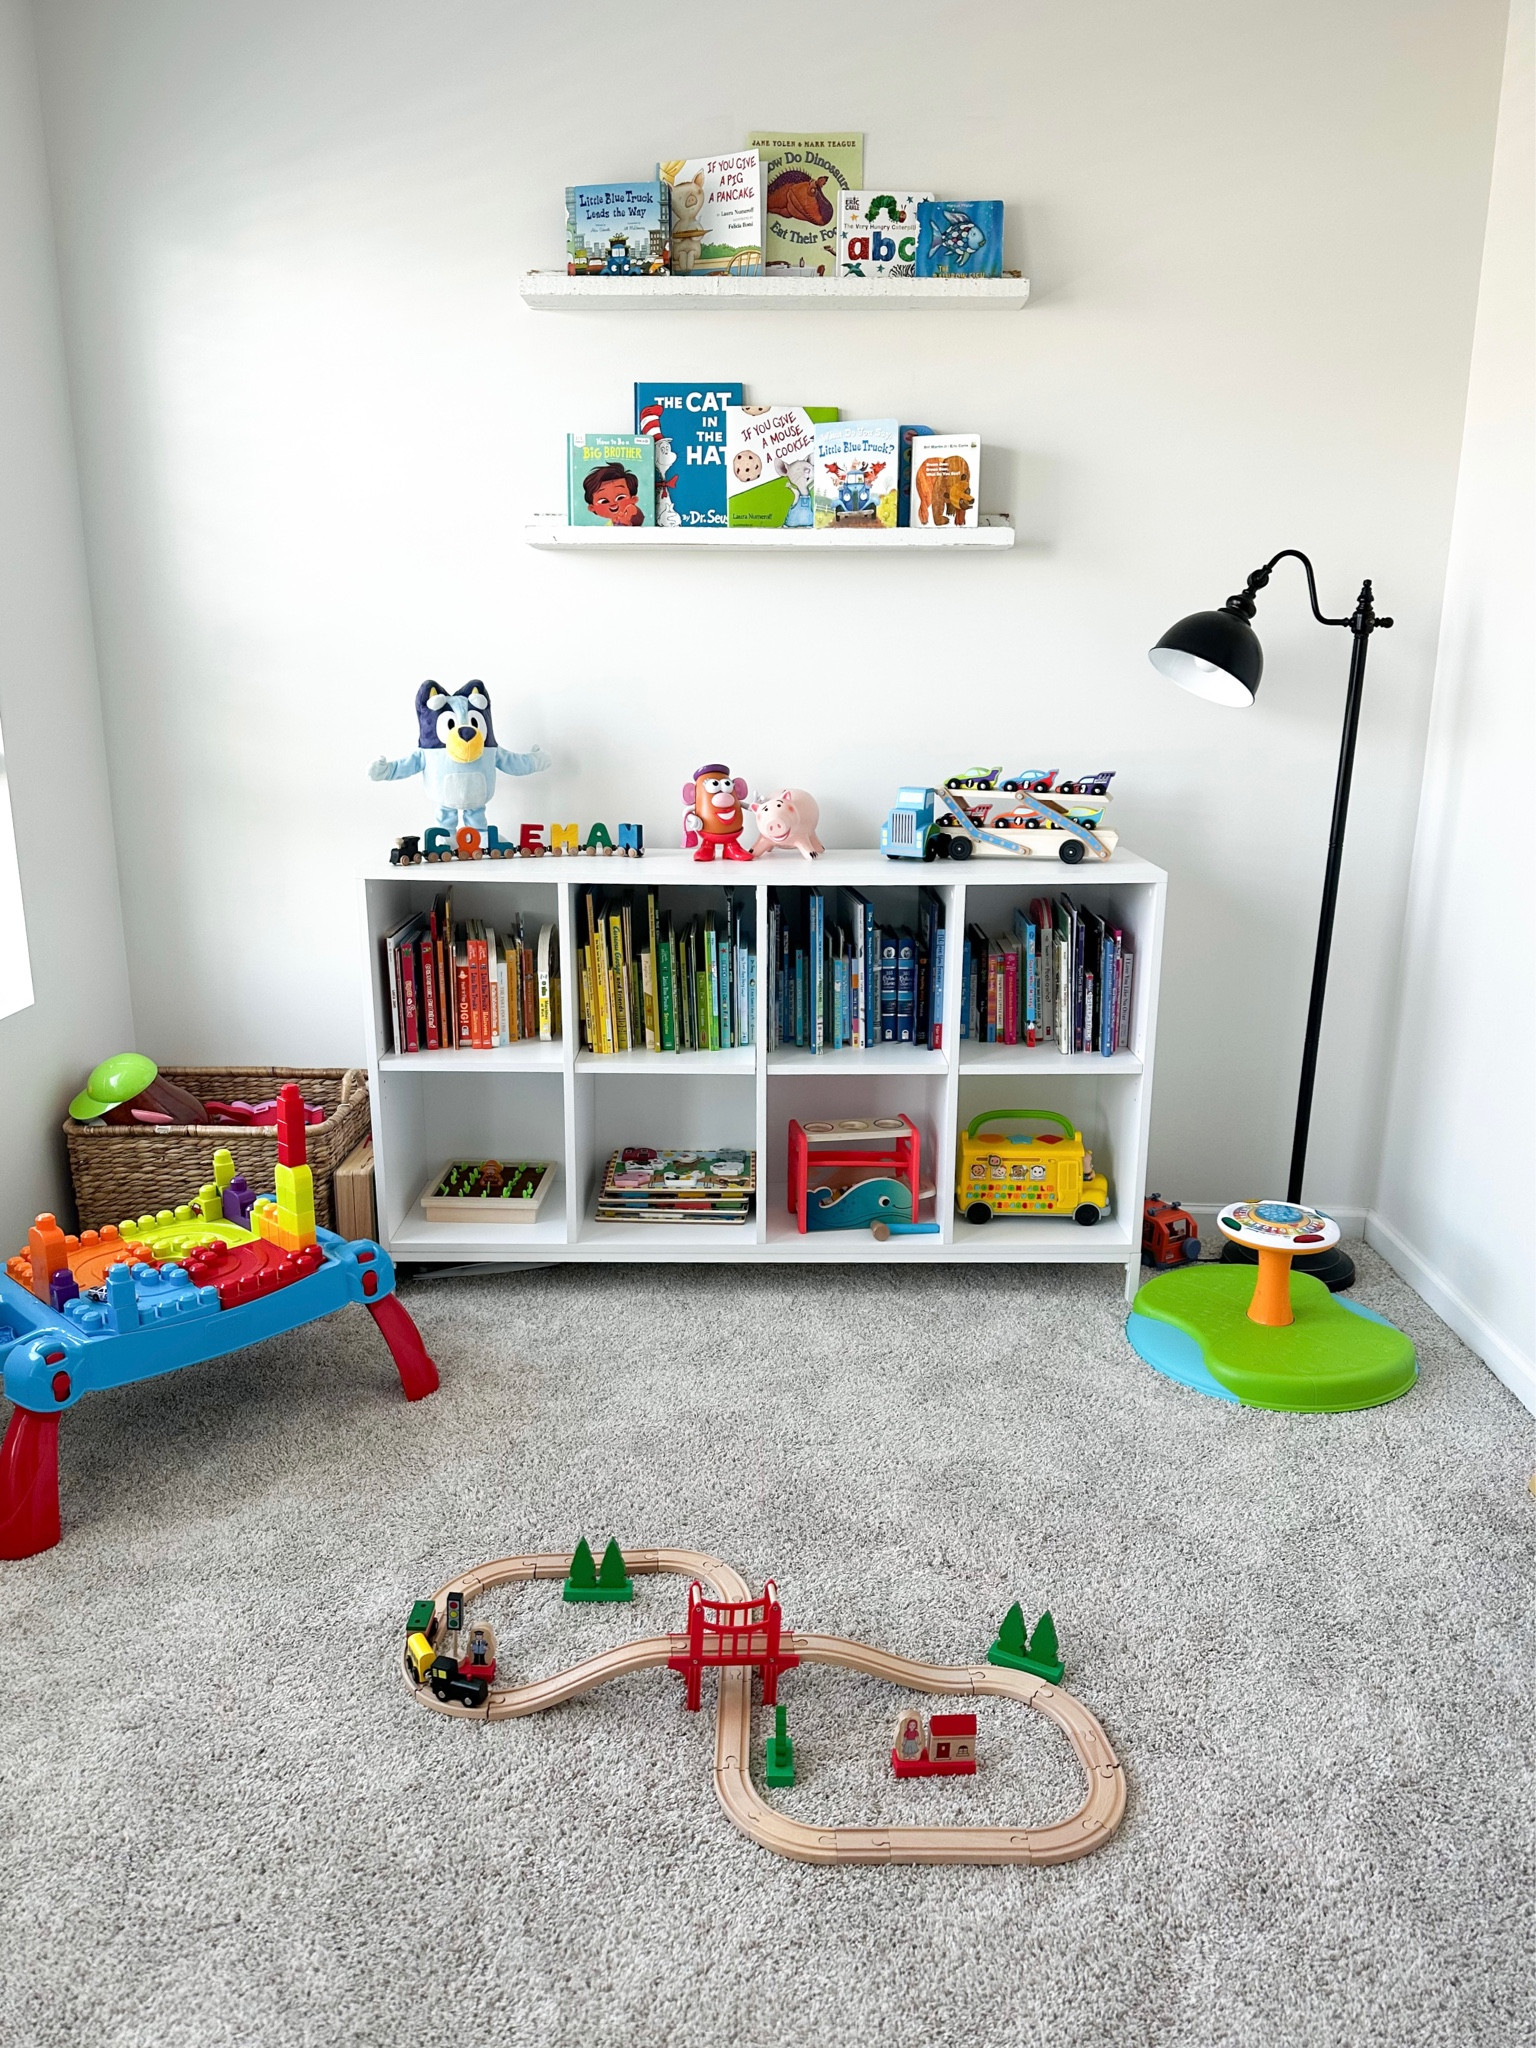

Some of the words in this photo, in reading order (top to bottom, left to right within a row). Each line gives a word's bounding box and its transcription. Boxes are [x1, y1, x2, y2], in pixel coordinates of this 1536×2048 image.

[707, 161, 717, 174] IF
[719, 158, 734, 171] YOU
[736, 156, 756, 170] GIVE
[768, 156, 783, 173] ow
[784, 151, 802, 164] Do
[805, 151, 850, 190] Dinosaur
[720, 176, 725, 187] A
[727, 172, 744, 186] PIG
[579, 194, 604, 207] Little
[605, 193, 624, 205] Blue
[626, 190, 654, 204] Truck
[708, 192, 714, 204] A
[716, 187, 755, 202] PANCAKE
[586, 208, 609, 220] Leads
[614, 208, 626, 218] the
[628, 206, 647, 218] Way
[770, 221, 788, 240] Eat
[790, 230, 818, 244] Their
[820, 226, 837, 241] Foo
[848, 231, 916, 262] abc
[654, 396, 682, 409] THE
[686, 391, 732, 412] CAT
[702, 416, 718, 428] IN
[741, 428, 752, 442] IF
[753, 420, 771, 436] YOU
[773, 412, 796, 428] GIVE
[696, 432, 722, 442] THE
[762, 438, 768, 448] A
[770, 424, 804, 445] MOUSE
[604, 446, 642, 459] BROTHER
[766, 453, 772, 463] A
[776, 435, 811, 458] COOKIE
[818, 444, 841, 458] Little
[843, 442, 862, 453] Blue
[862, 440, 895, 454] Truck?
[690, 510, 706, 524] Dr.
[1080, 784, 1086, 794] 3
[1015, 816, 1021, 825] 4
[424, 822, 643, 858] COLEMAN
[460, 1002, 469, 1024] DIG!
